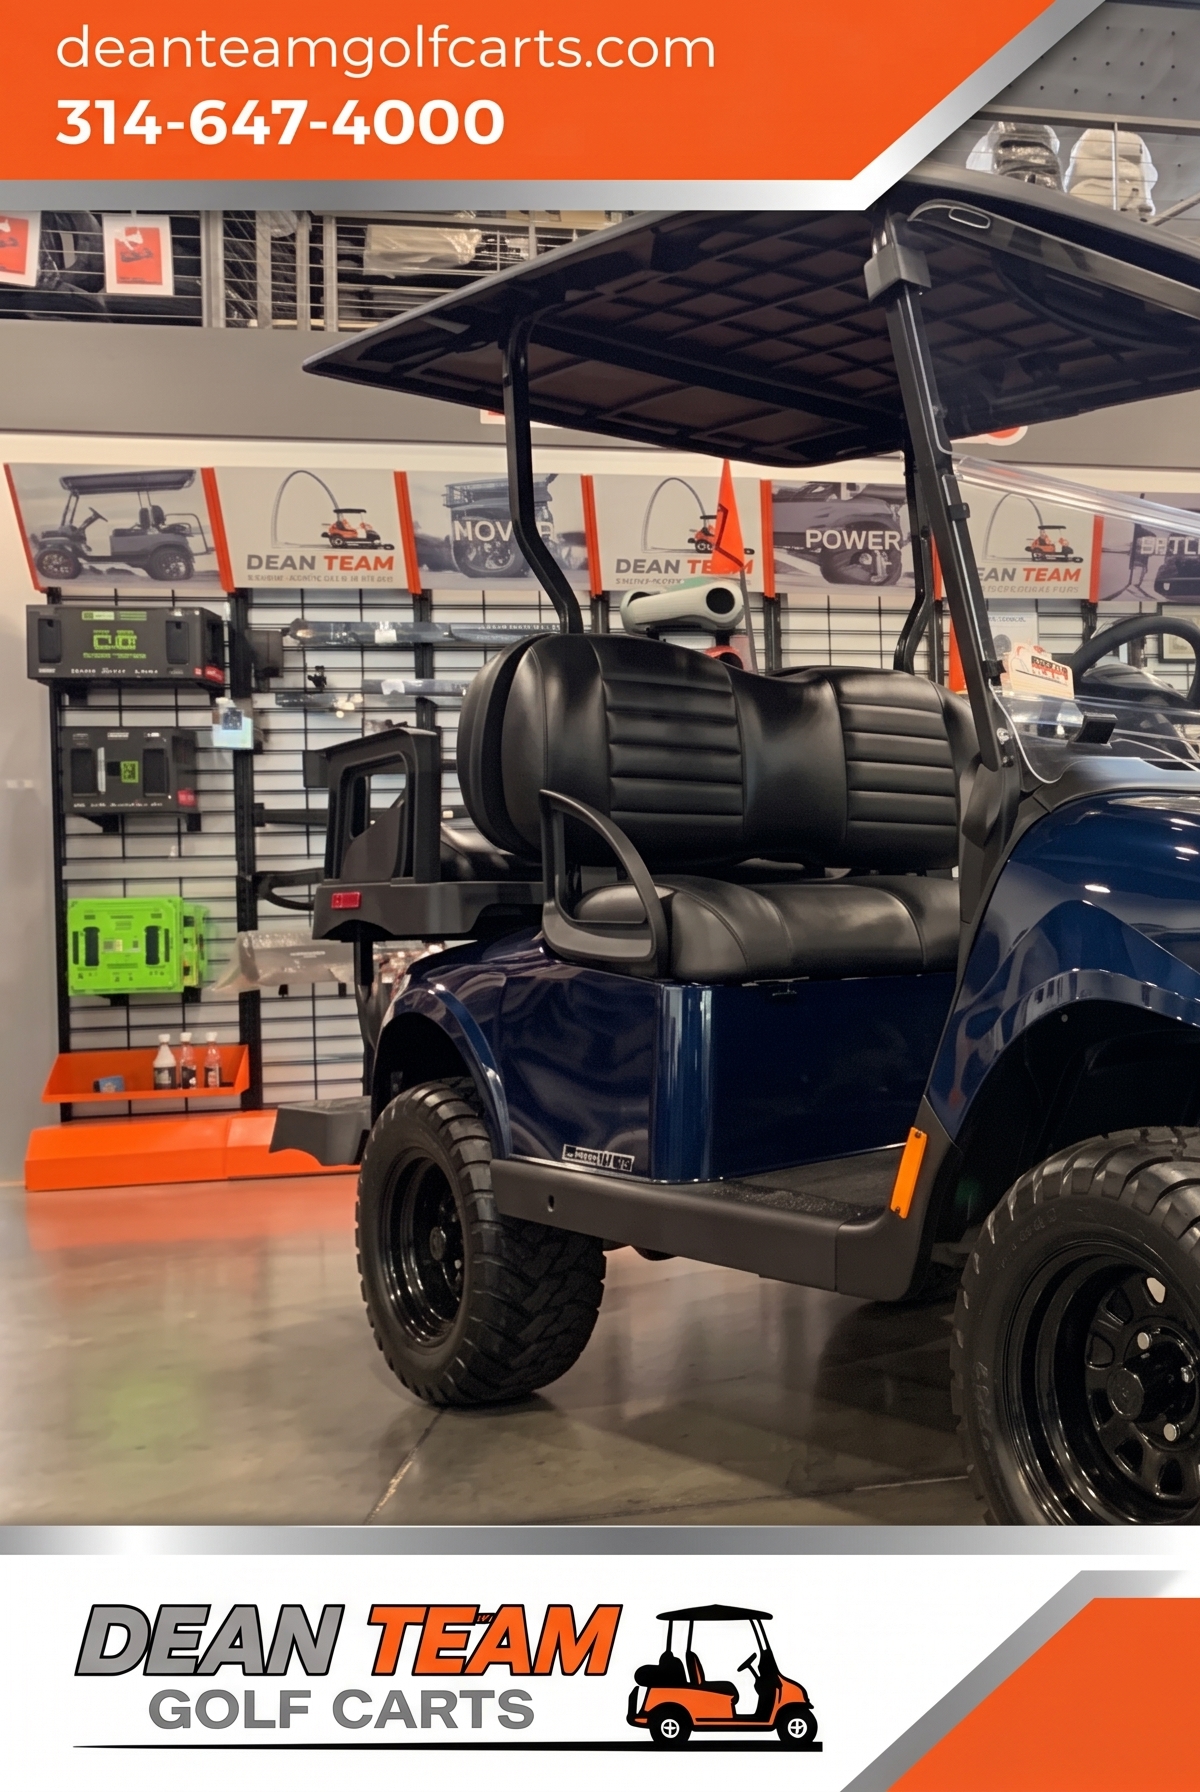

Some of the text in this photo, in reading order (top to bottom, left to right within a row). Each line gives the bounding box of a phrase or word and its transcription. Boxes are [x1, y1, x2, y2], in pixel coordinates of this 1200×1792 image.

[453, 520, 555, 542] NOVR
[805, 529, 901, 551] POWER
[246, 554, 394, 571] DEAN TEAM
[615, 558, 681, 574] DEAN
[974, 567, 1082, 582] EAN TEAM
